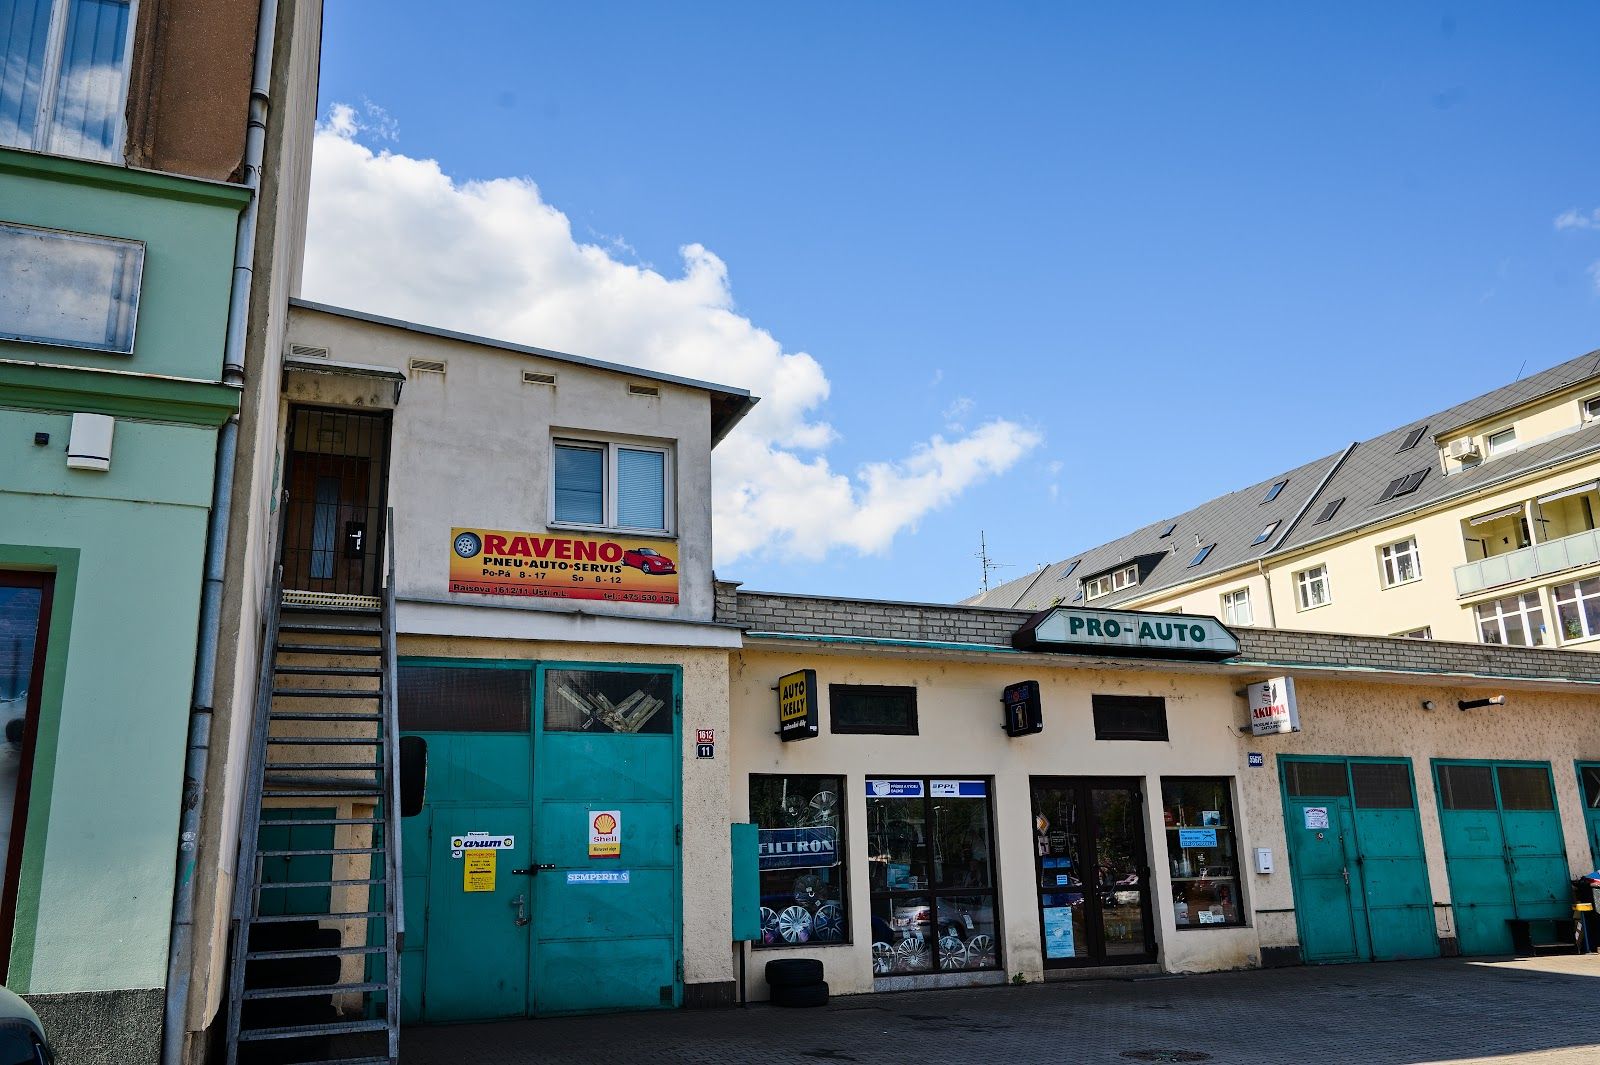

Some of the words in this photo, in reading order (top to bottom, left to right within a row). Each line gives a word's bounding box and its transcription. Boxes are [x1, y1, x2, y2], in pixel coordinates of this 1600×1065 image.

[484, 534, 624, 562] RAVENO
[482, 568, 511, 578] Po-Pá
[453, 584, 491, 593] Raisova
[1069, 616, 1206, 642] PRO-AUTO
[783, 681, 805, 700] AUTO
[784, 698, 805, 716] KELLY
[1253, 704, 1286, 719] AKUMA
[699, 731, 712, 739] 1612
[702, 746, 710, 756] 11
[758, 840, 834, 854] FILTRON
[568, 873, 618, 881] SEMPERIT
